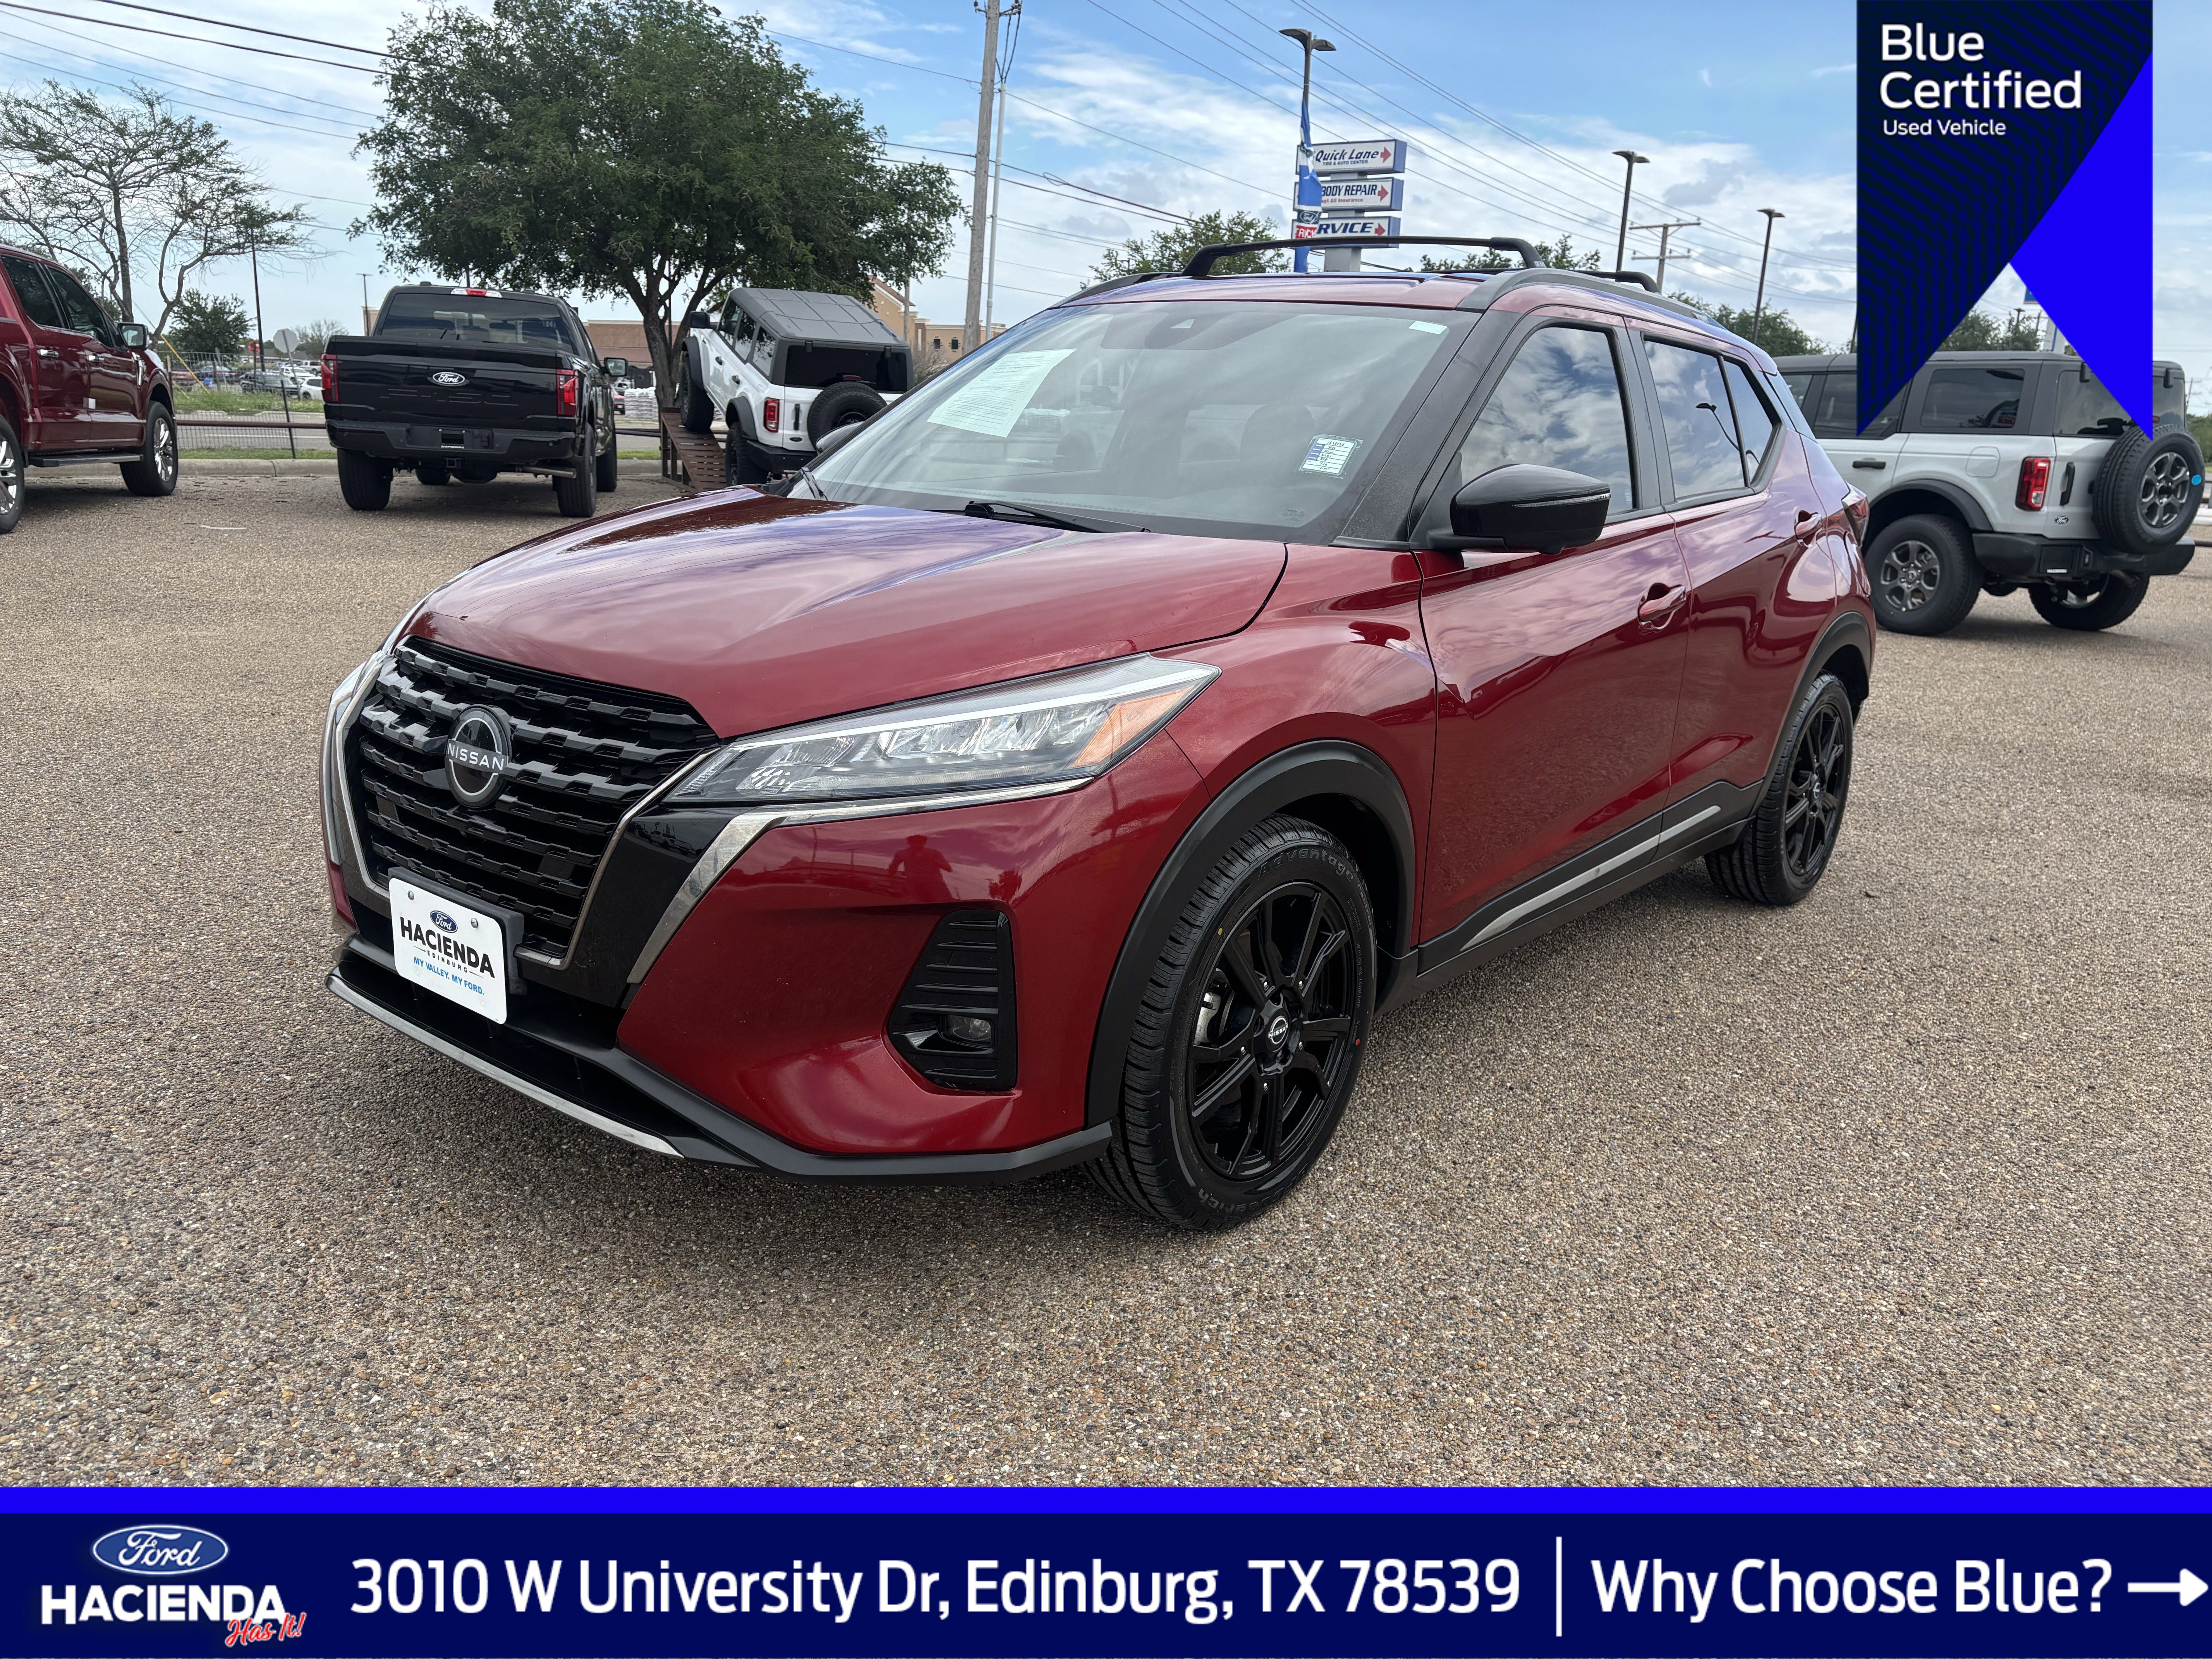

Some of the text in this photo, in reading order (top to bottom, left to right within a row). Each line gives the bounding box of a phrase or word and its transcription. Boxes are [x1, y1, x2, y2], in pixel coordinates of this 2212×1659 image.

[1316, 149, 1379, 162] Quick Lane
[1321, 184, 1378, 196] BODY REPAIR
[1317, 222, 1374, 234] RVICE
[438, 373, 459, 383] Ford
[448, 743, 504, 771] NISSAN
[435, 913, 453, 931] Ford
[400, 916, 495, 979] HACIENDA
[427, 950, 468, 973] EDINBURG
[414, 956, 484, 996] MY VALLEY. MY FORD.
[1268, 1022, 1288, 1038] NISSAN
